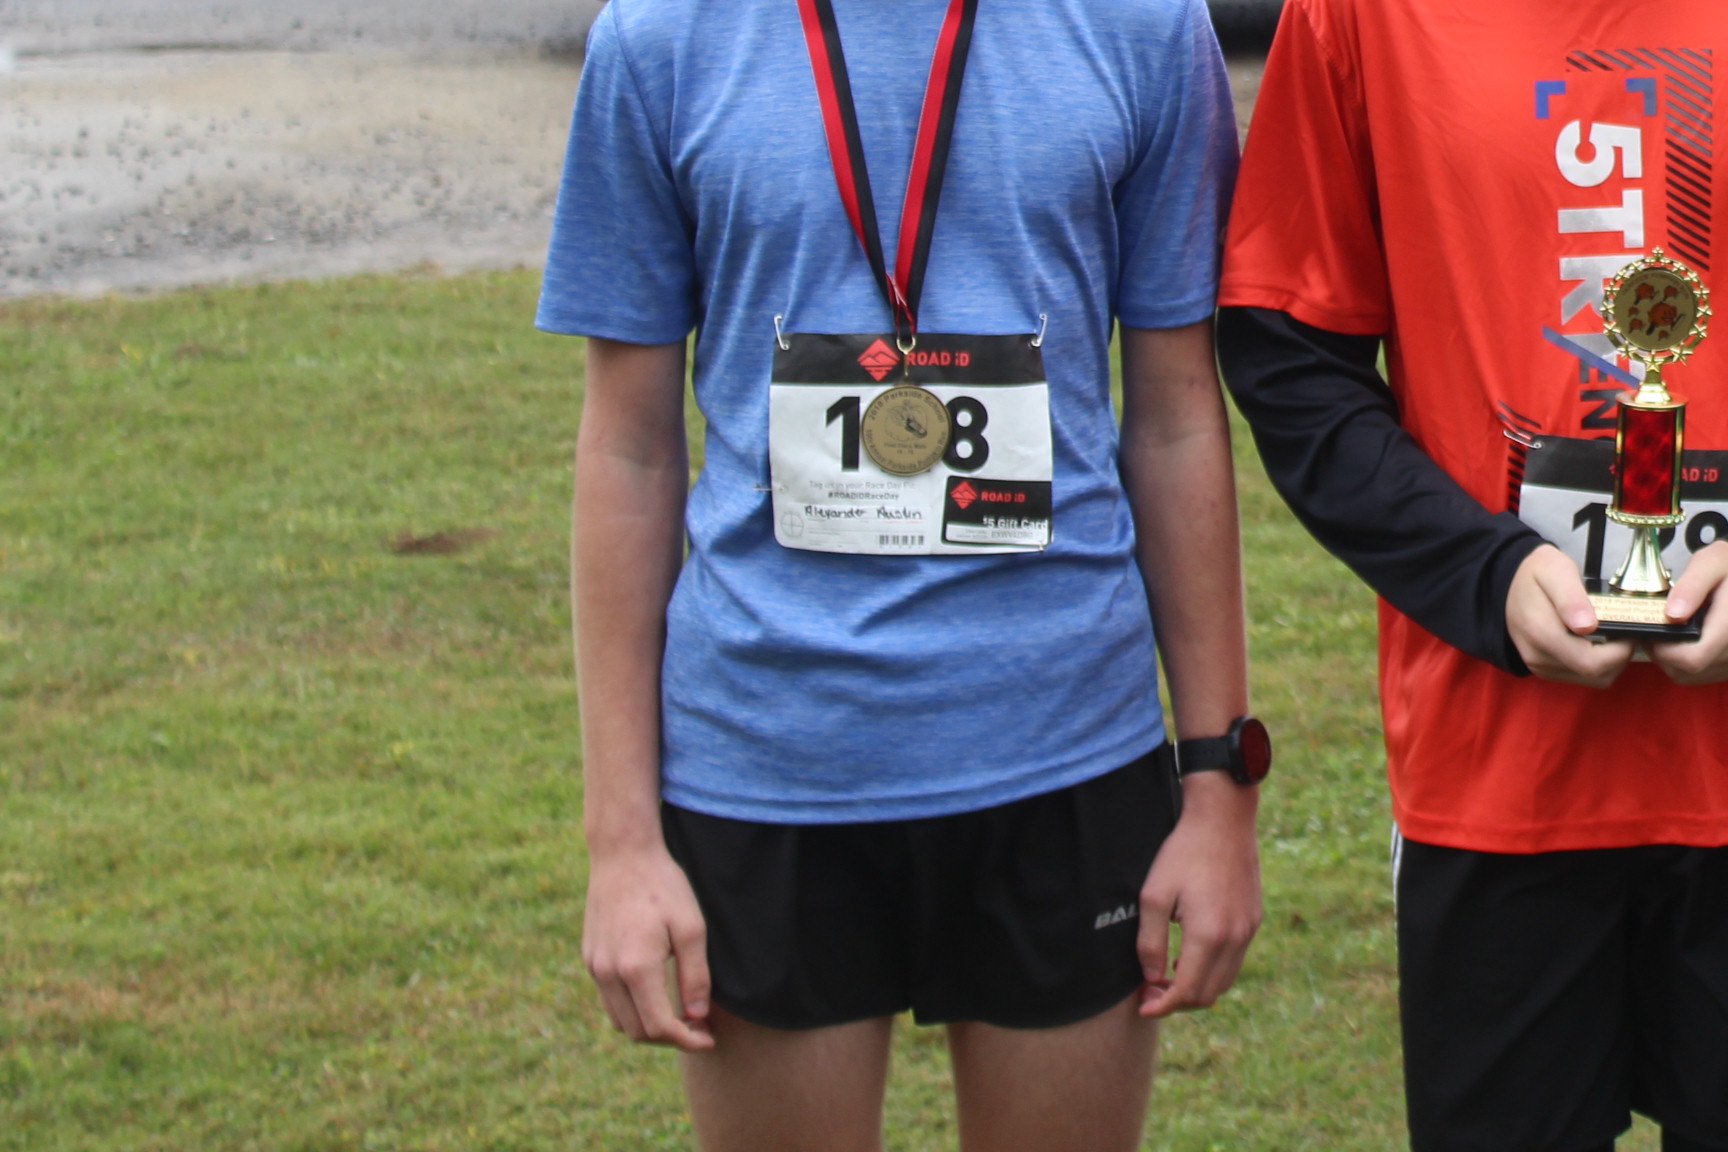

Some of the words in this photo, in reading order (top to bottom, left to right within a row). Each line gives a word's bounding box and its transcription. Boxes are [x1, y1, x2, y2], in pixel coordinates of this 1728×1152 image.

[907, 351, 951, 366] ROAD
[824, 395, 990, 474] 18
[1682, 467, 1700, 482] AD
[981, 491, 1011, 502] ROAD
[997, 517, 1018, 529] Gift
[1020, 517, 1048, 531] Card
